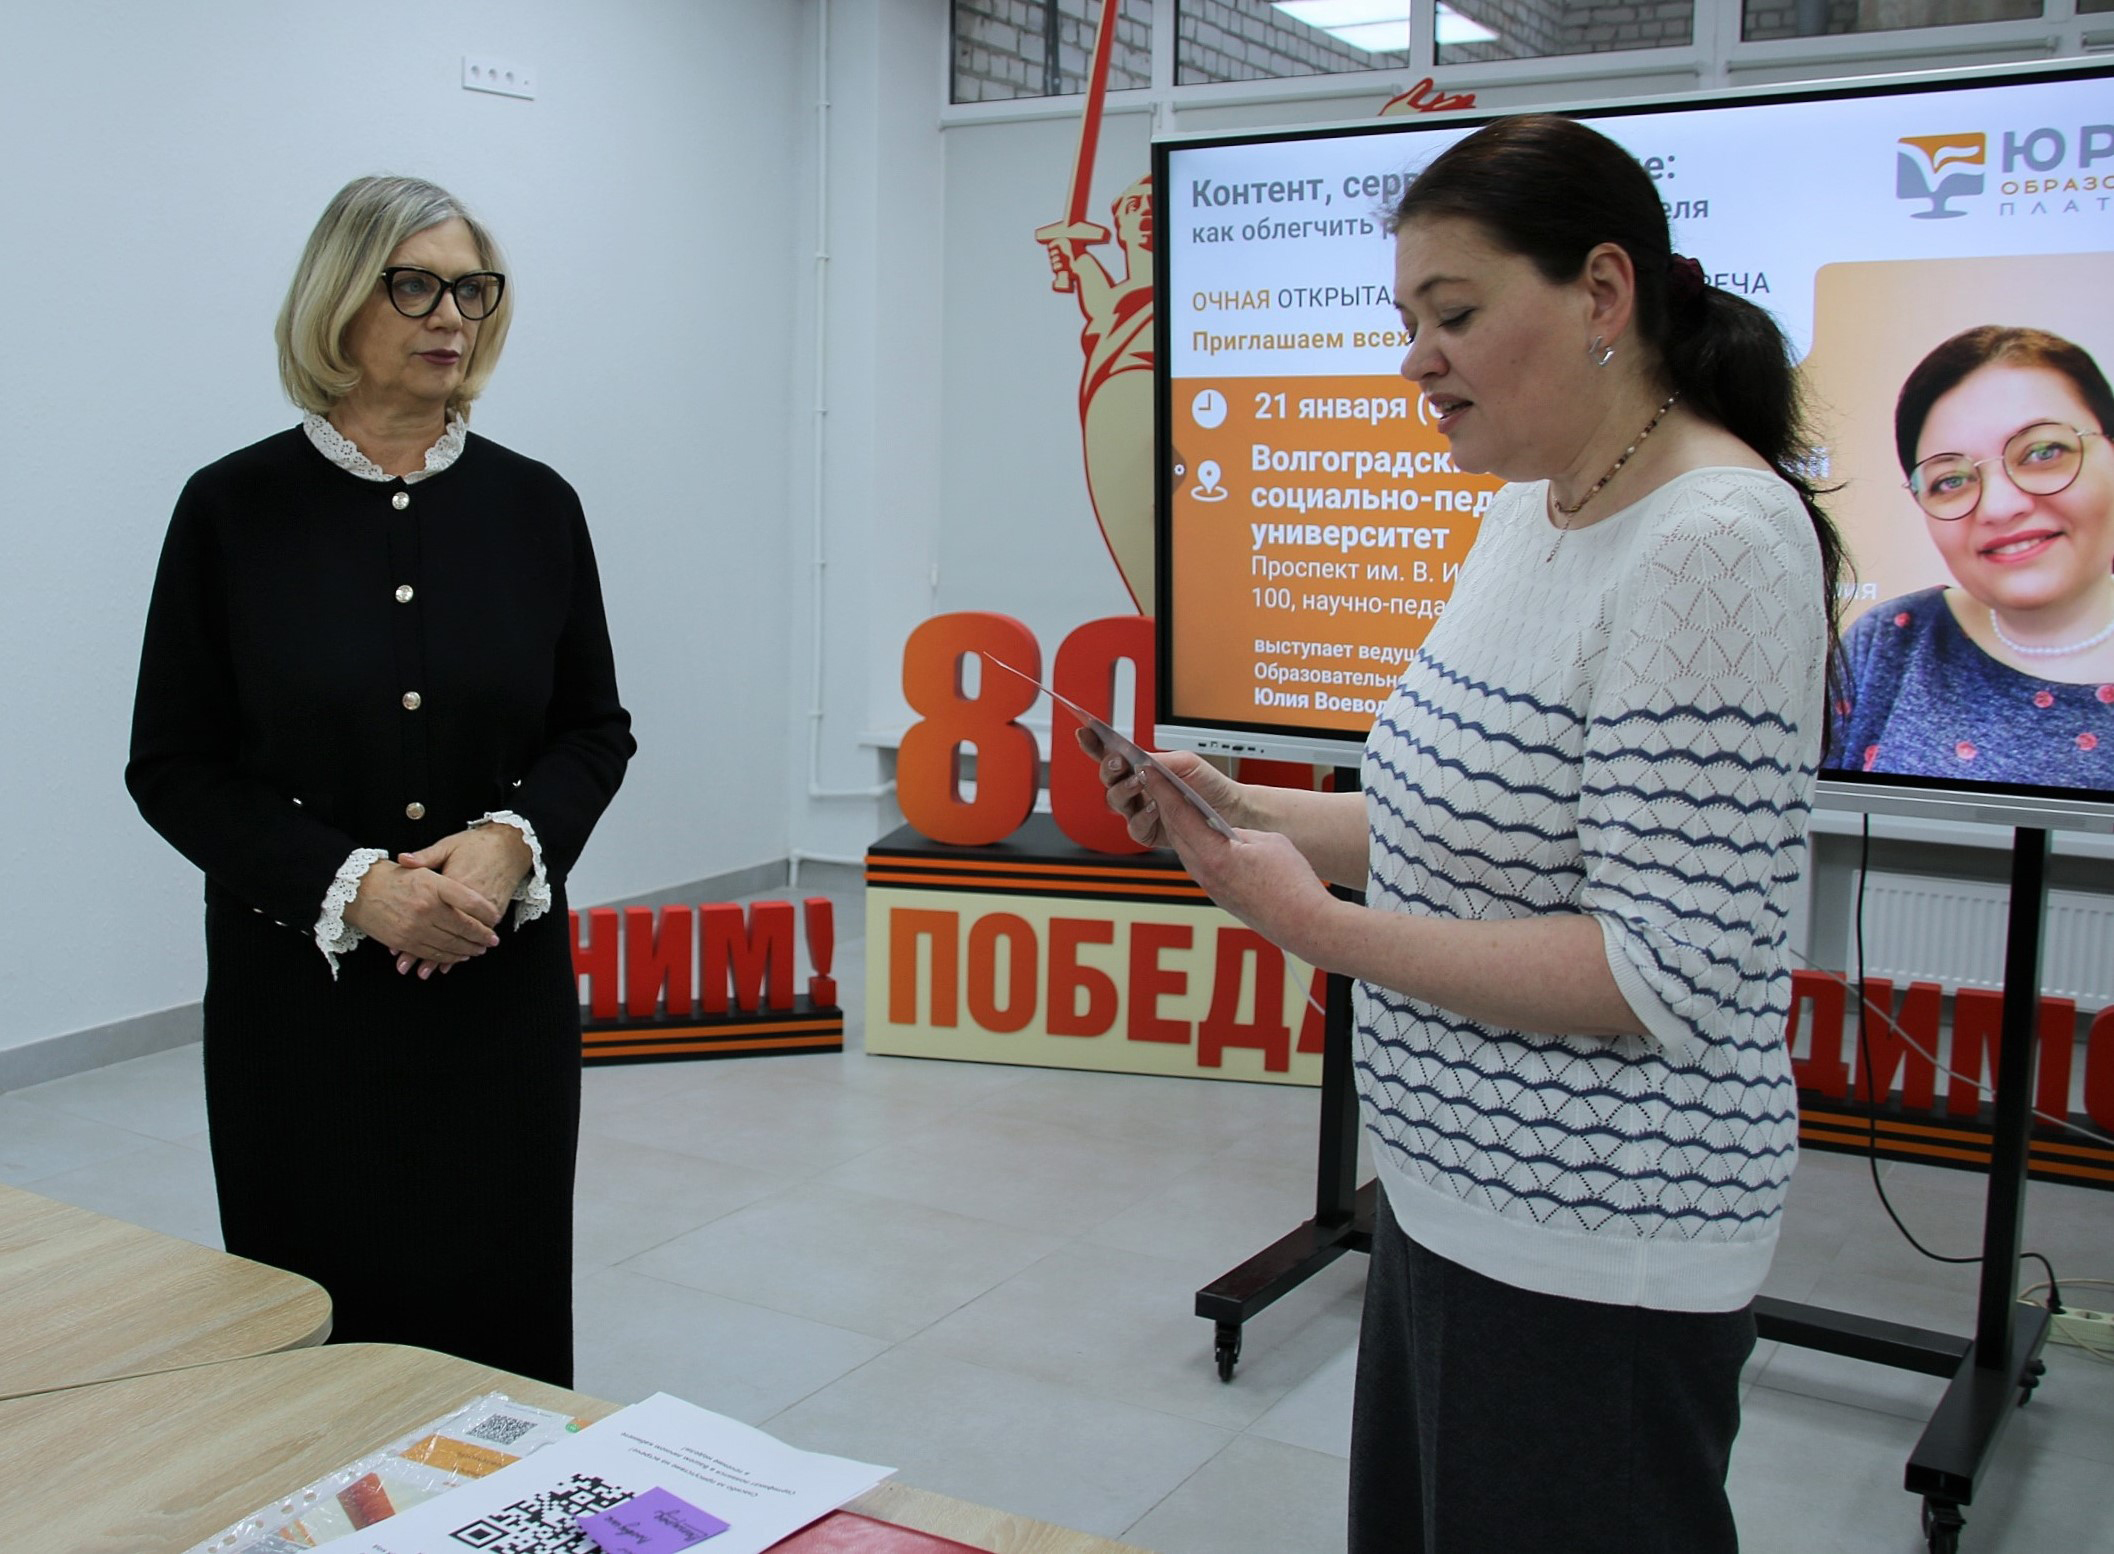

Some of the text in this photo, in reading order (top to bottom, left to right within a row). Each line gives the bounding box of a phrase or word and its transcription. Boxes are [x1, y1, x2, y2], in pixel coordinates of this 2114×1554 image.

[1192, 178, 1332, 207] Контент,
[1192, 225, 1234, 244] как
[1242, 217, 1374, 241] облегчить
[1193, 290, 1270, 312] ОЧНАЯ
[1278, 285, 1394, 308] ОТКРЫТА
[1193, 330, 1409, 356] Приглашаем всех
[1254, 392, 1287, 420] 21
[1298, 398, 1407, 426] января
[1251, 443, 1462, 479] Волгоградск
[1251, 522, 1450, 553] университет
[1251, 555, 1359, 581] Проспект
[1367, 563, 1405, 582] им.
[1413, 561, 1434, 583] В.
[1252, 587, 1296, 613] 100,
[1254, 639, 1353, 660] выступает
[1254, 662, 1402, 688] Образовательн
[1254, 687, 1309, 709] Юлия
